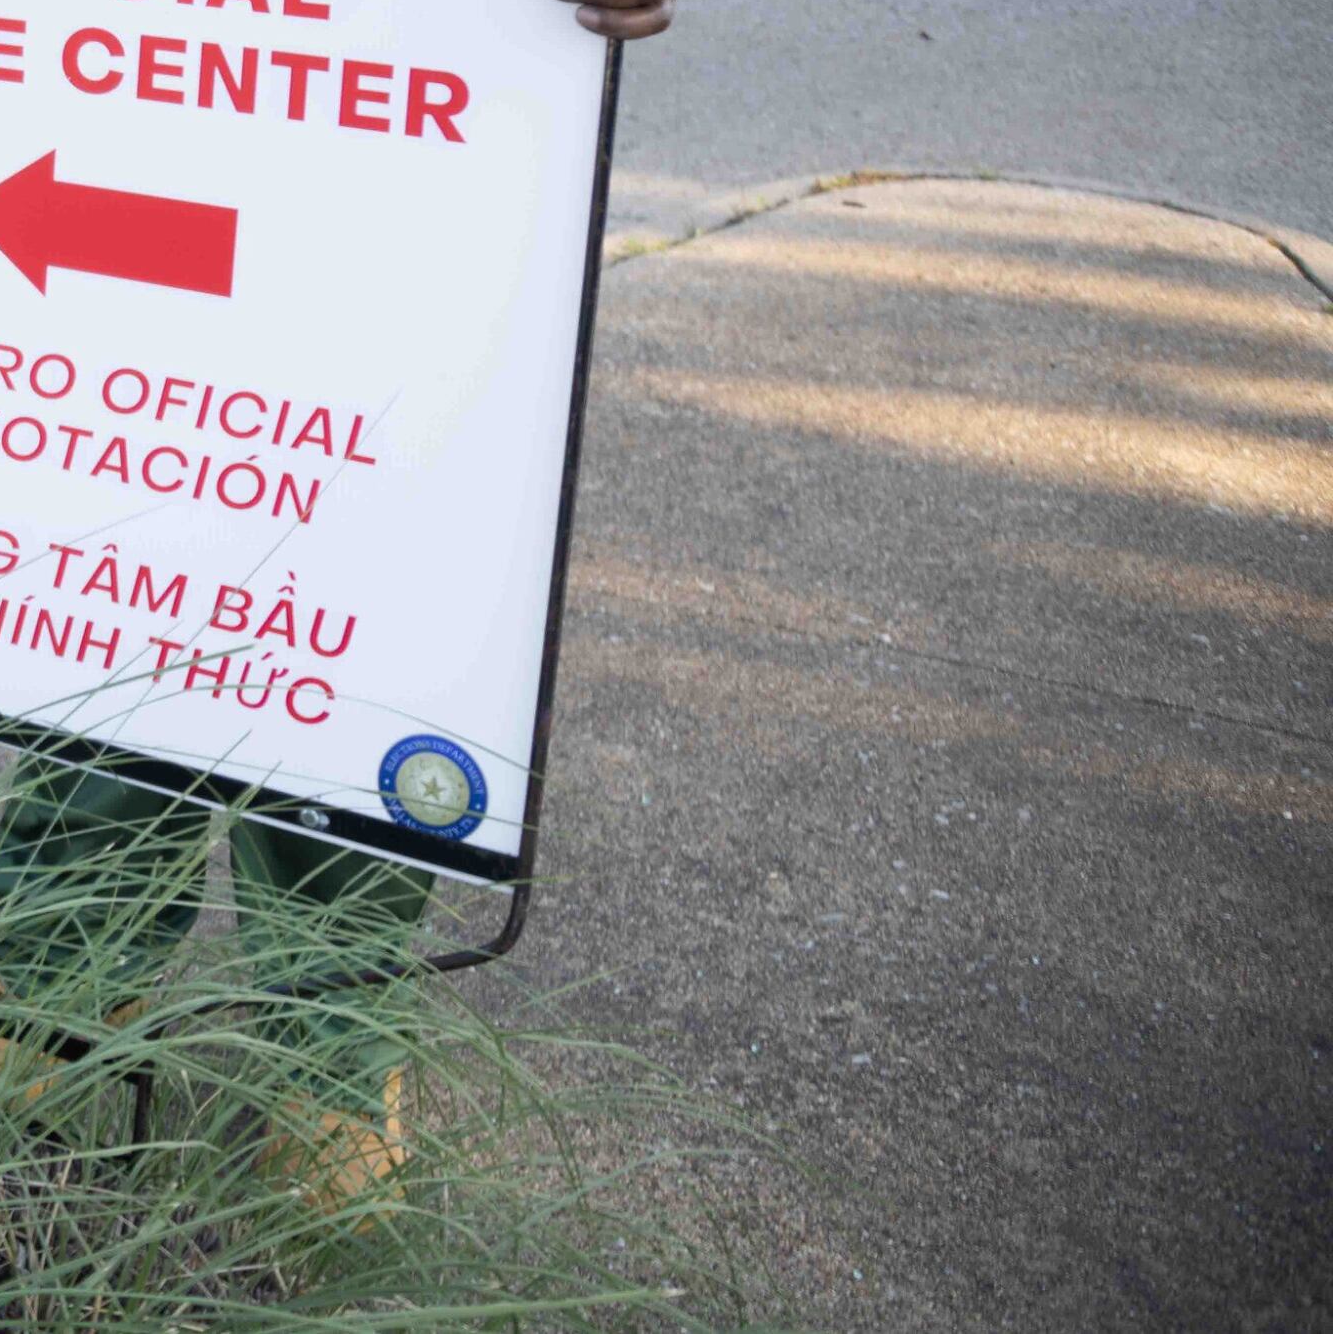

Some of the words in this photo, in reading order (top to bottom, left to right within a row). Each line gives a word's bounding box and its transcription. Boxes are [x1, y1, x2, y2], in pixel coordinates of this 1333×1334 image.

[61, 26, 470, 143] CENTER
[101, 367, 376, 466] OFICIAL
[49, 543, 189, 618] TÂM
[208, 570, 358, 659] BẦU
[147, 636, 335, 726] THỨC
[432, 740, 485, 794] DEPARTMENT
